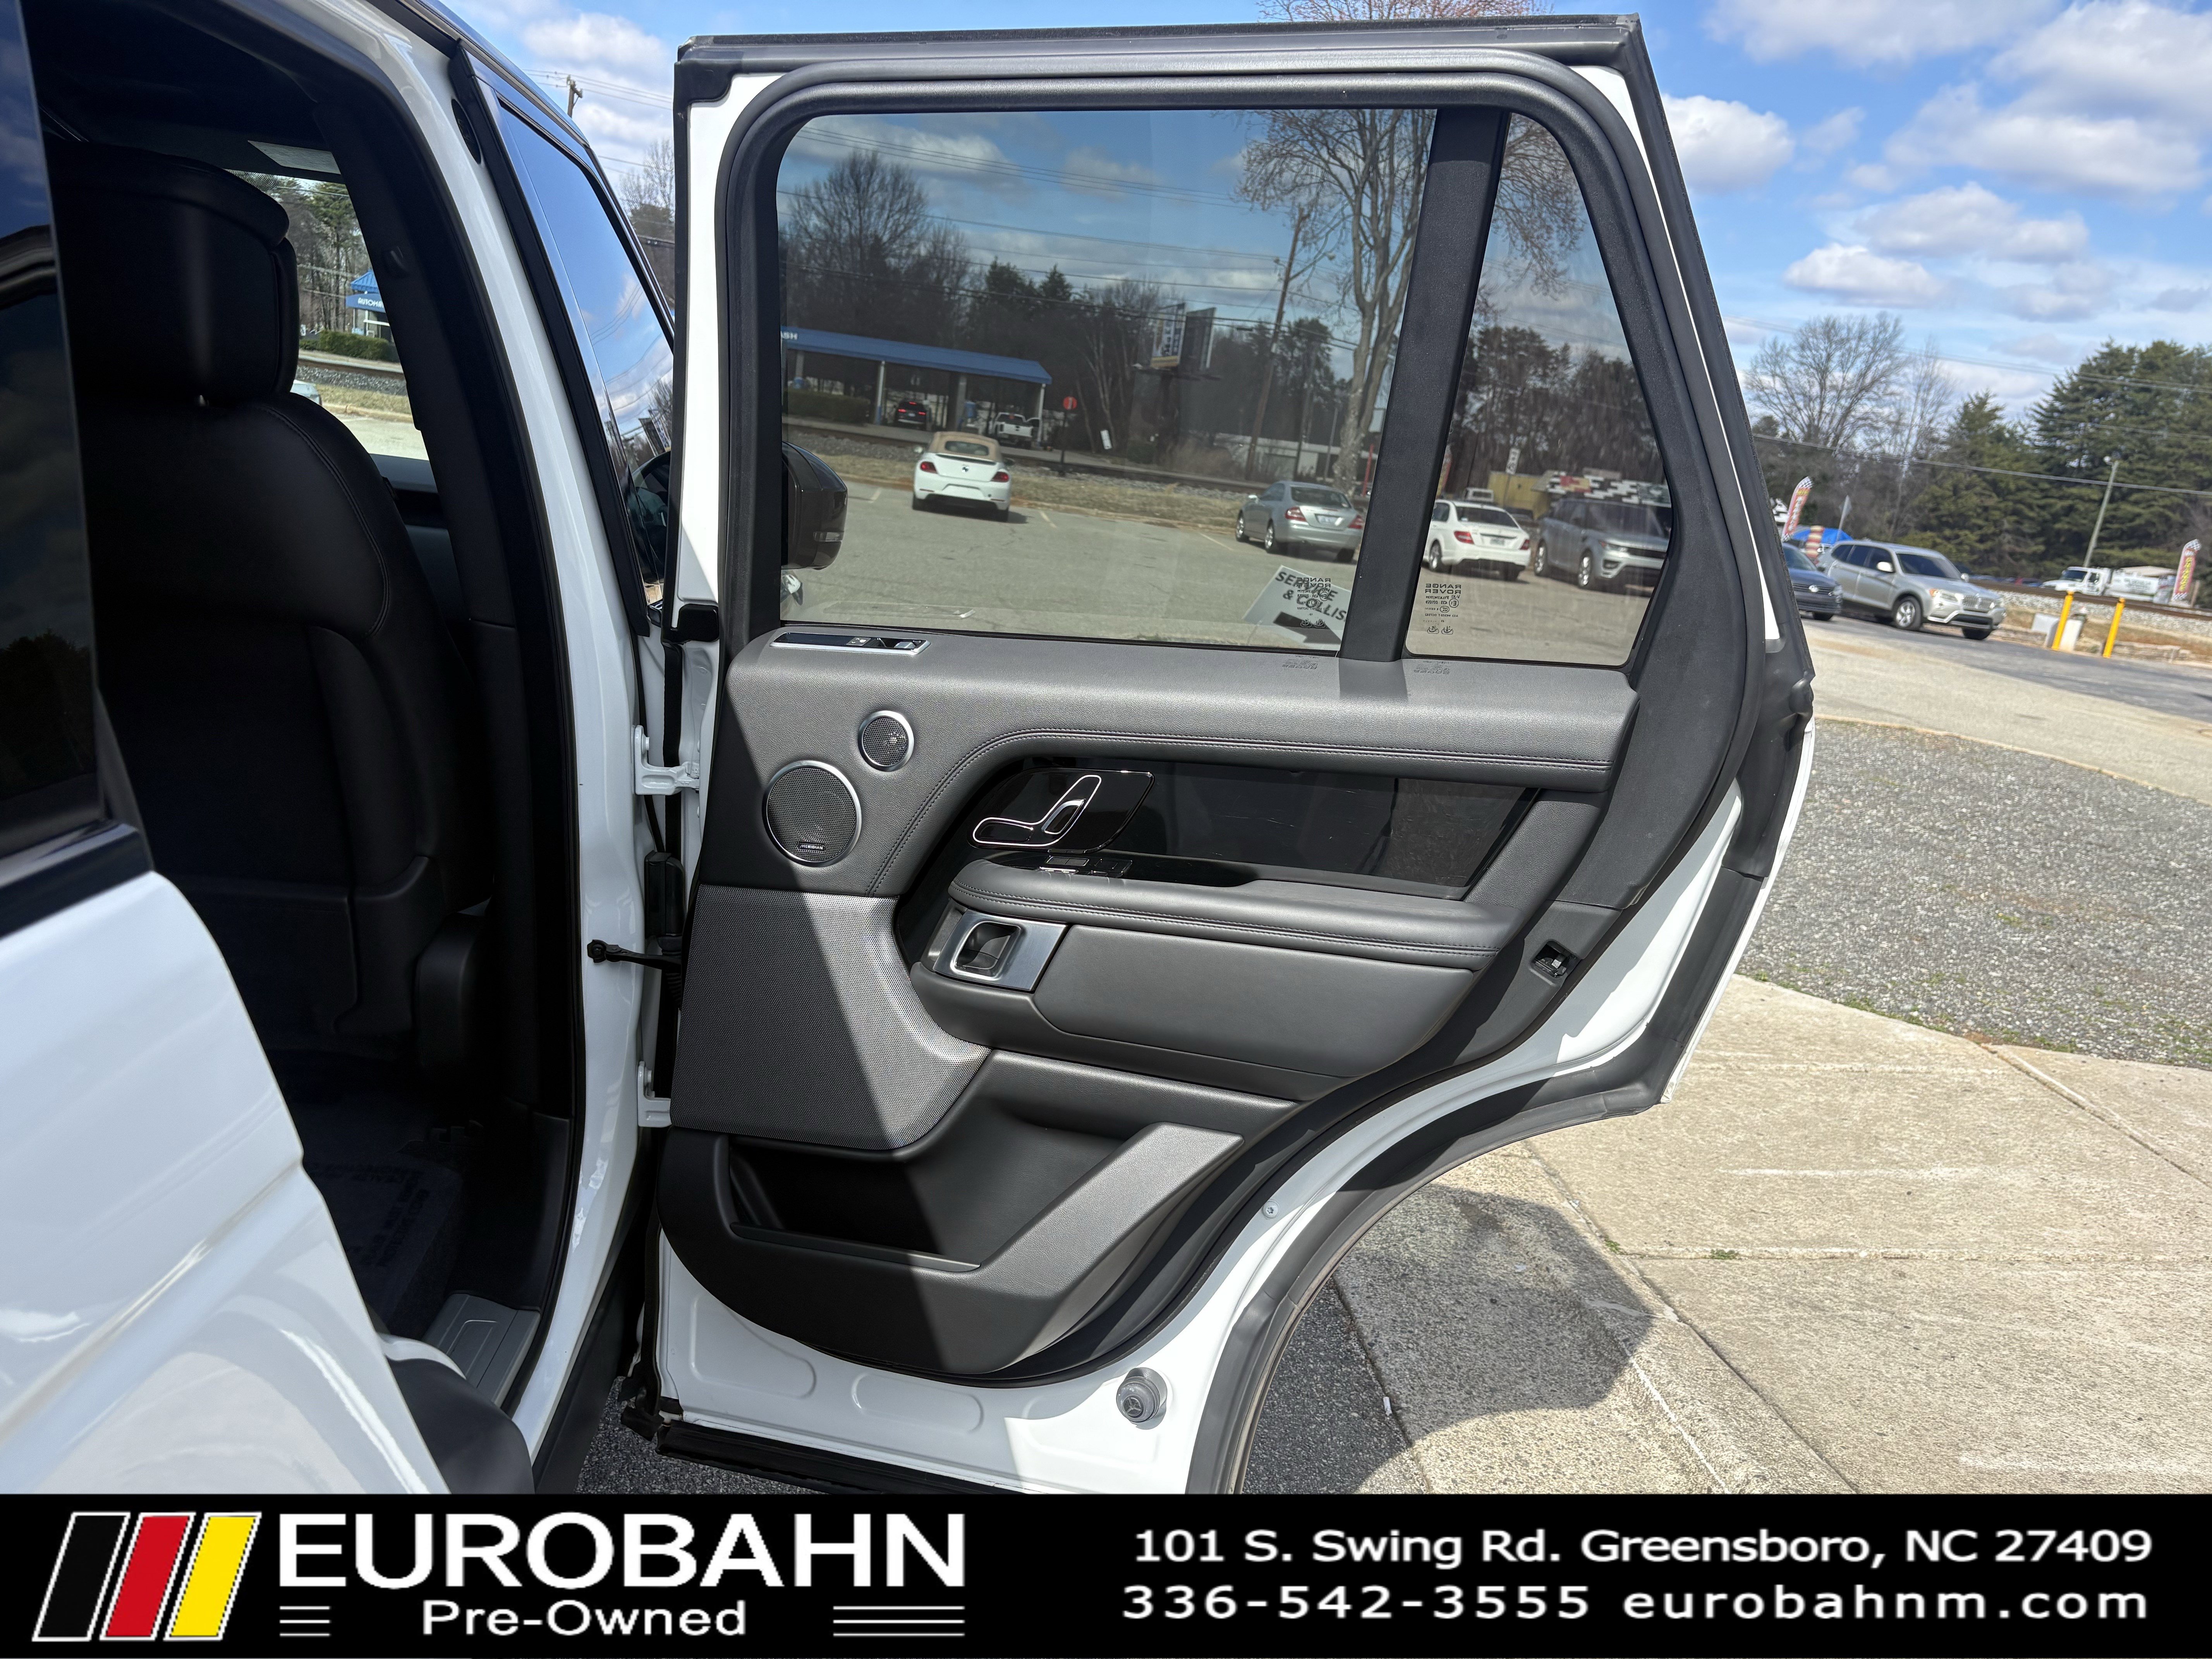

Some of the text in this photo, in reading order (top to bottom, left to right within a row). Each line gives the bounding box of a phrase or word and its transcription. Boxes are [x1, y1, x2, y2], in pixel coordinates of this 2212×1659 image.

[1275, 571, 1338, 601] SERVICE
[1283, 589, 1347, 621] & COLLIS
